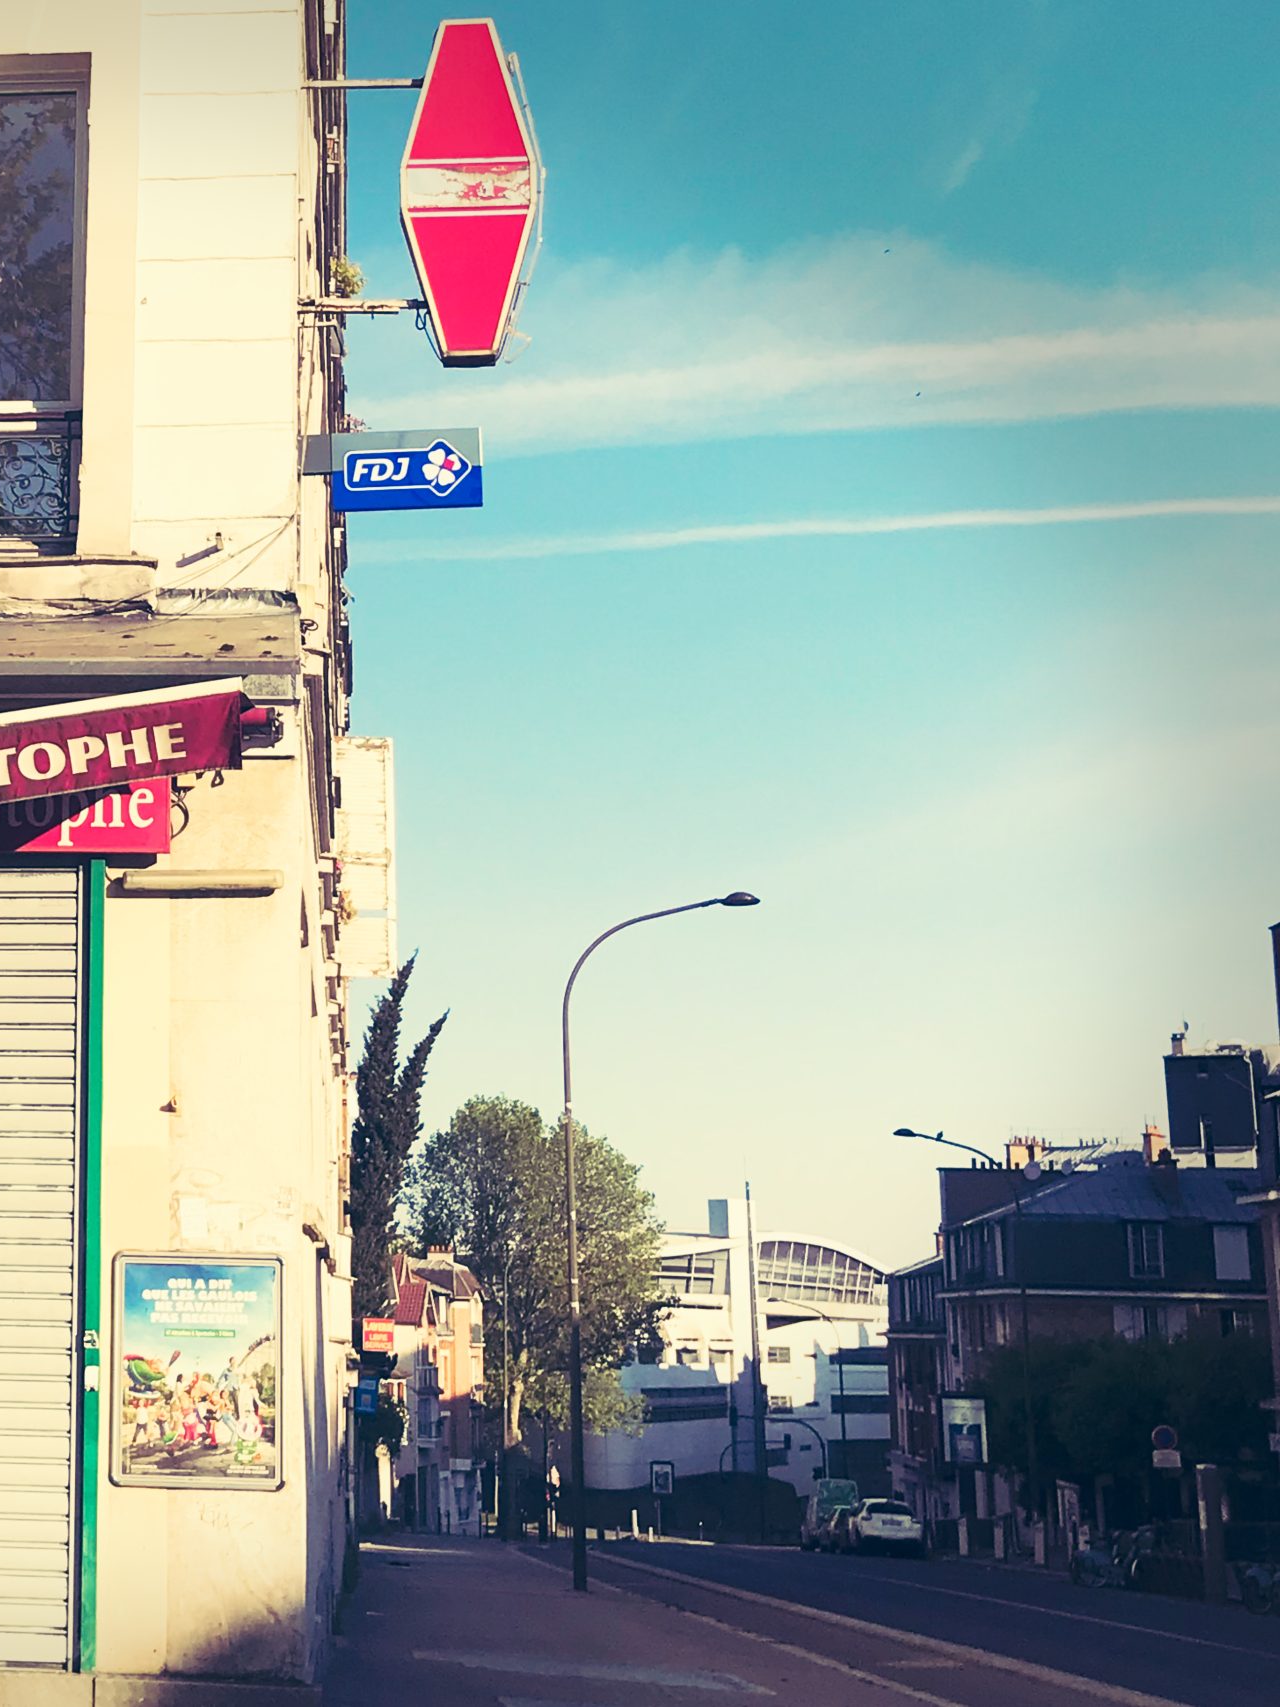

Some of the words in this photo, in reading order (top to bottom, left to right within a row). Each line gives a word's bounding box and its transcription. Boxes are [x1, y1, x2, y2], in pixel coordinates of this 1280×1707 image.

[352, 457, 410, 482] FDJ
[167, 1278, 192, 1290] QUI
[194, 1278, 206, 1290] A
